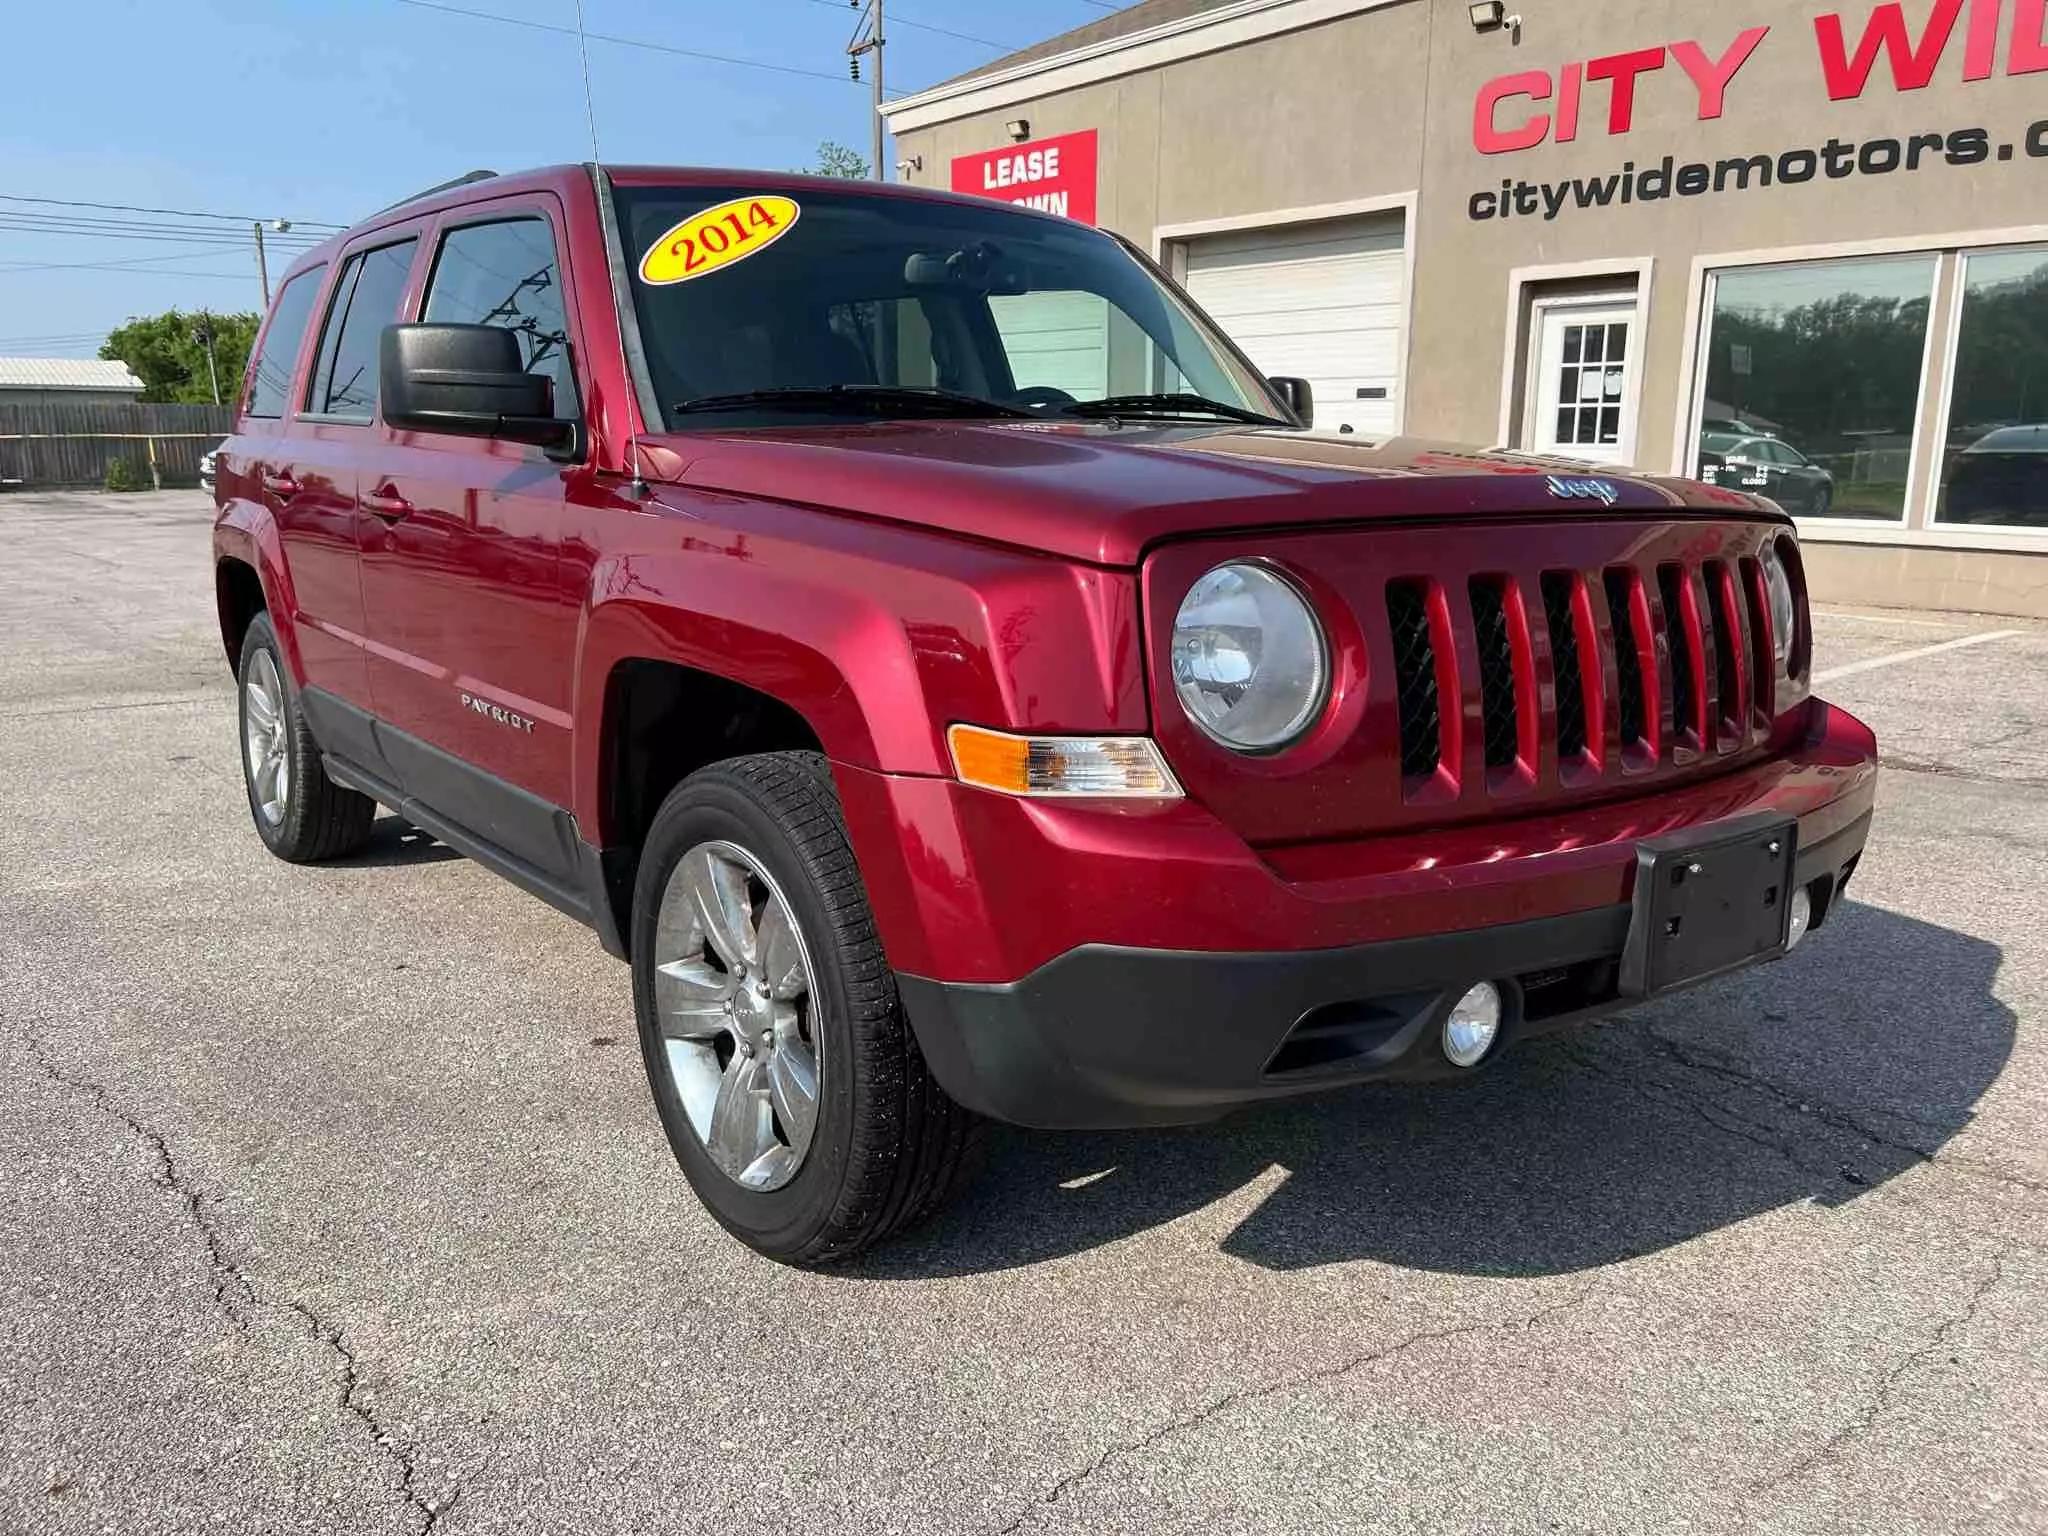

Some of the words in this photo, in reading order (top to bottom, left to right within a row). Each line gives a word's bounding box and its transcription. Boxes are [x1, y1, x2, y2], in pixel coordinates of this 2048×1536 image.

[1473, 26, 1770, 155] CITY
[983, 147, 1060, 190] LEASE
[1011, 191, 1069, 219] WN
[671, 202, 778, 272] 2014
[1545, 475, 1618, 506] Jeep
[460, 693, 536, 735] PATRIOT
